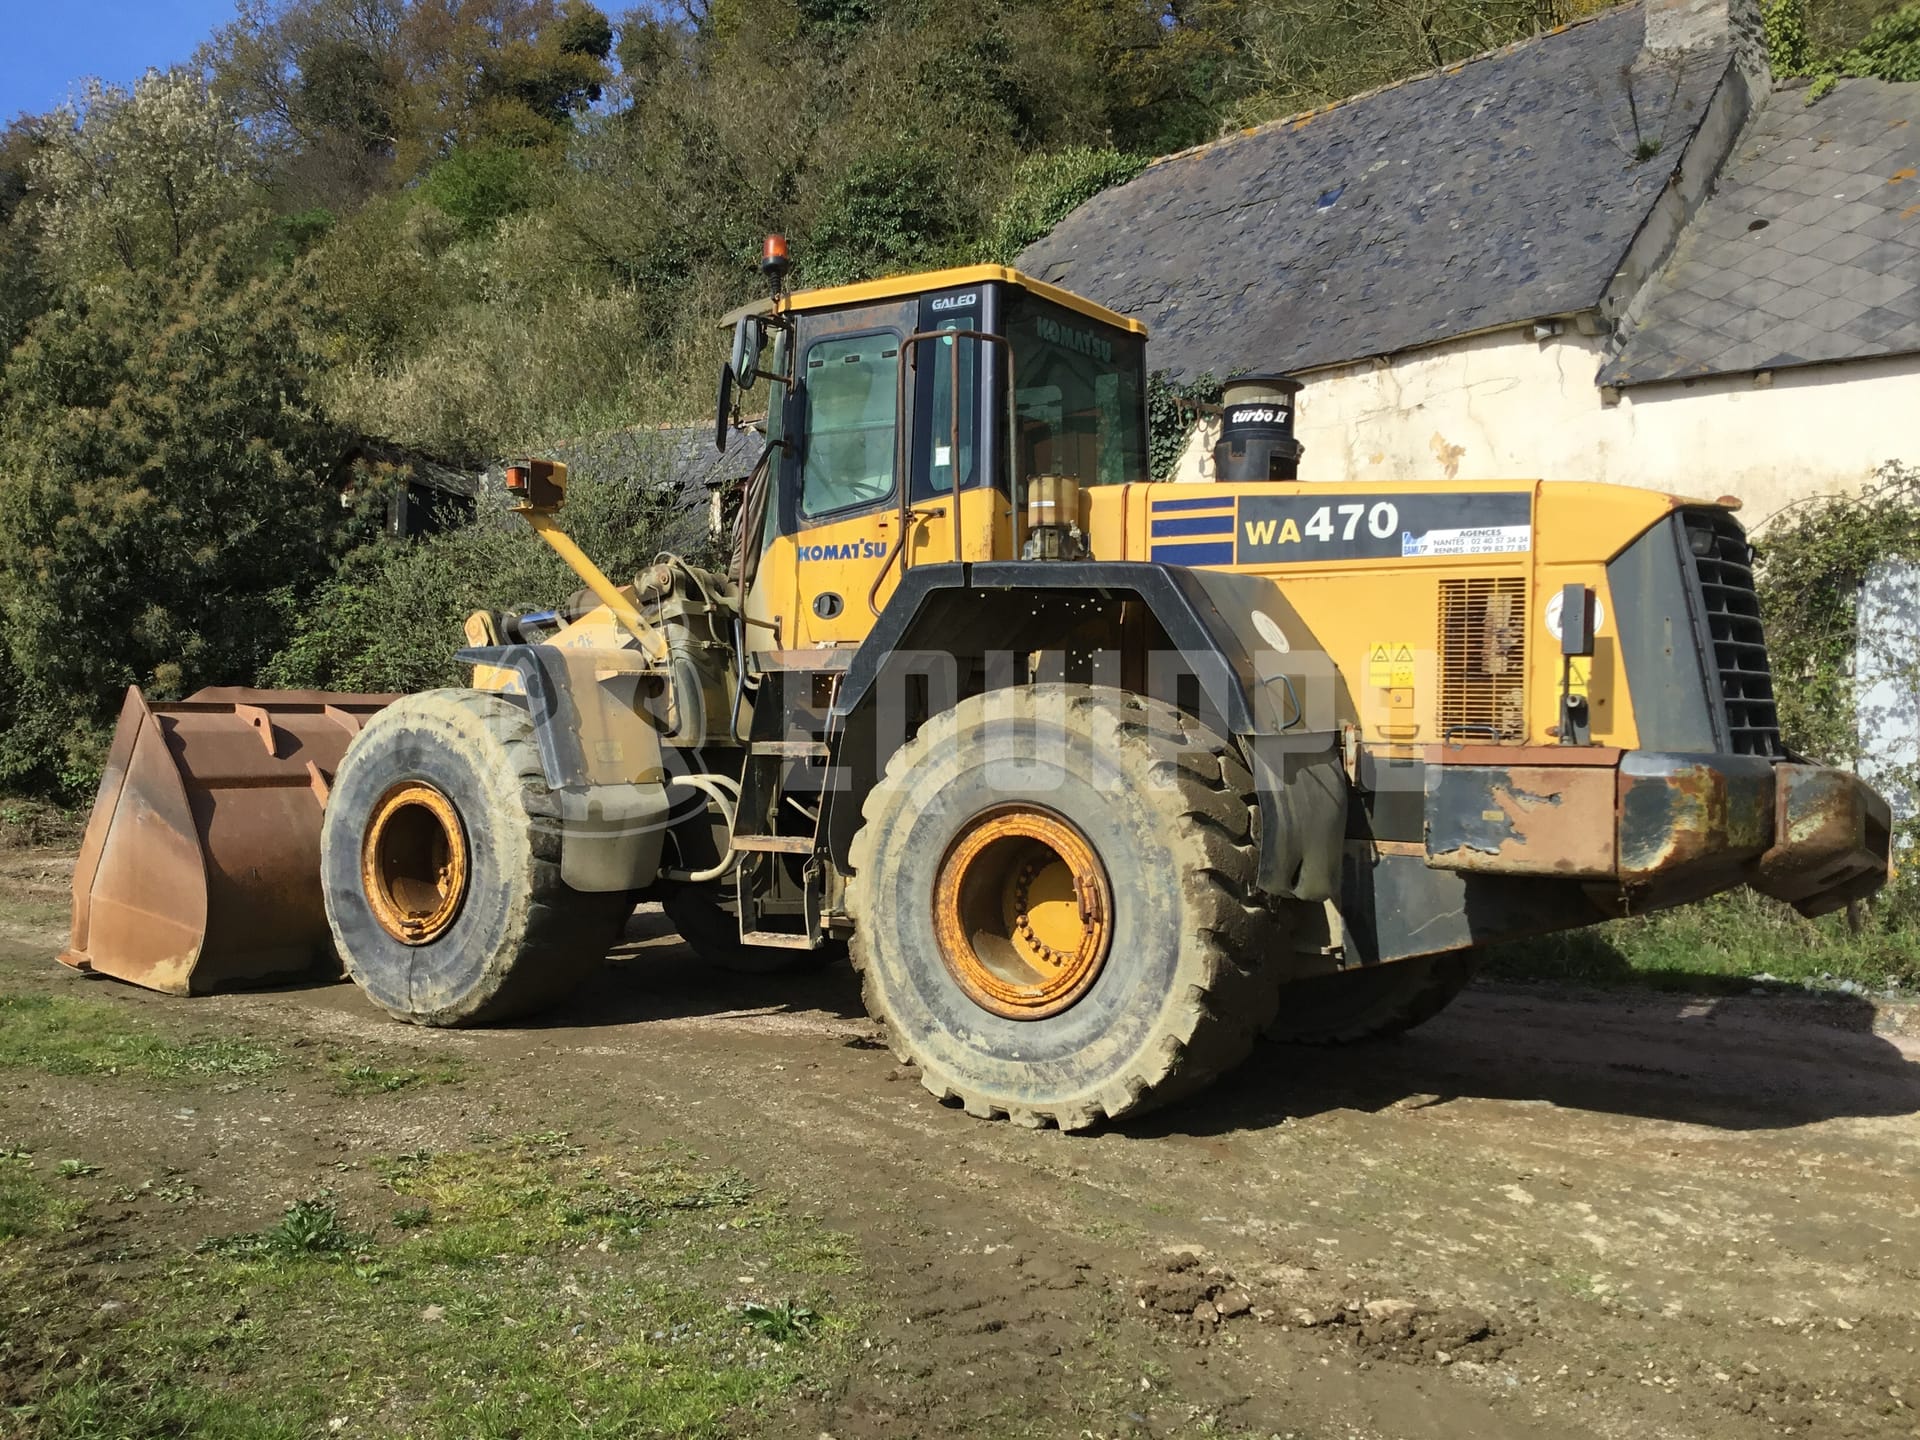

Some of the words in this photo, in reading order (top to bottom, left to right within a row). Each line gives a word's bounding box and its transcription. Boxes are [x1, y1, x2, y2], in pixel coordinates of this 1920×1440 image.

[932, 293, 977, 311] GALEO
[1036, 316, 1112, 364] KOMATSU
[1232, 409, 1274, 423] turbo
[1245, 518, 1301, 545] WA
[1305, 502, 1399, 542] 470
[1459, 529, 1502, 537] AGENCES
[798, 538, 887, 562] KOMATSU
